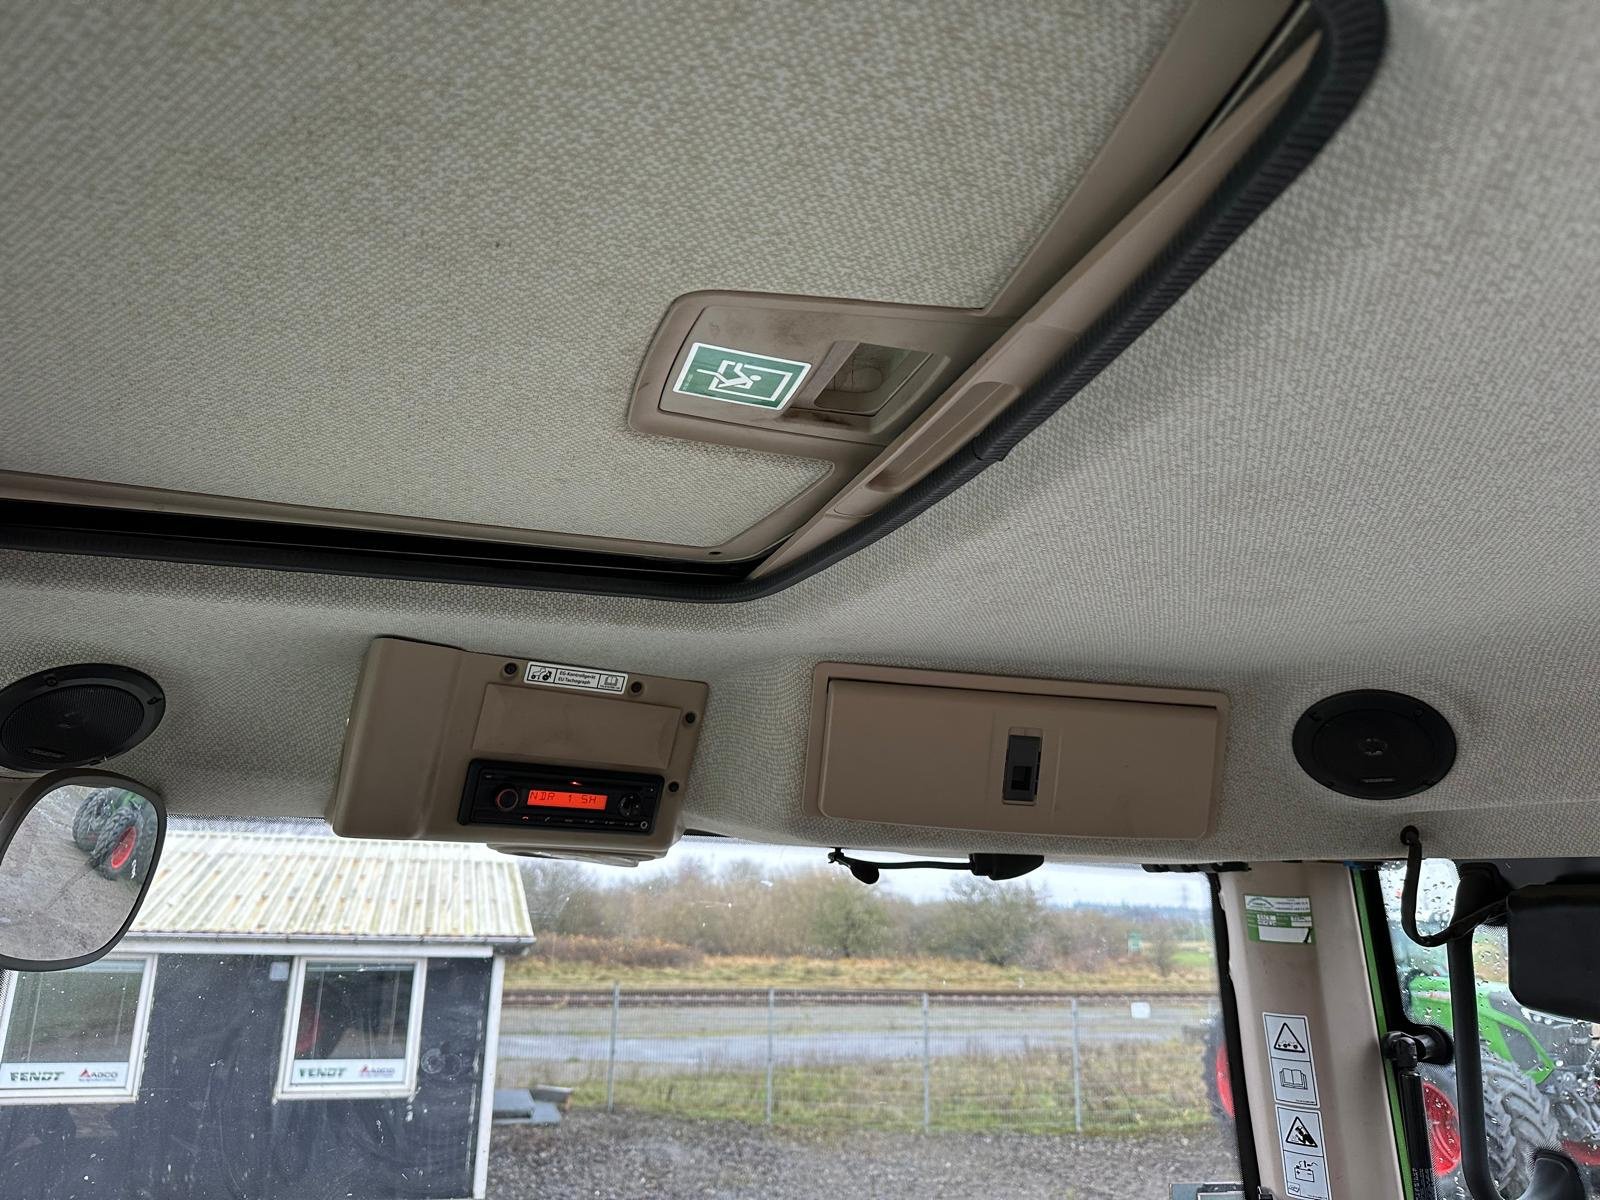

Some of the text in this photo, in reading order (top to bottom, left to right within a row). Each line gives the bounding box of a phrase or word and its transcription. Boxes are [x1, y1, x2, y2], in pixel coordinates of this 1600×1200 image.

[565, 677, 591, 685] Tachograph
[10, 1071, 64, 1082] FENDT
[299, 1067, 346, 1077] FENDT
